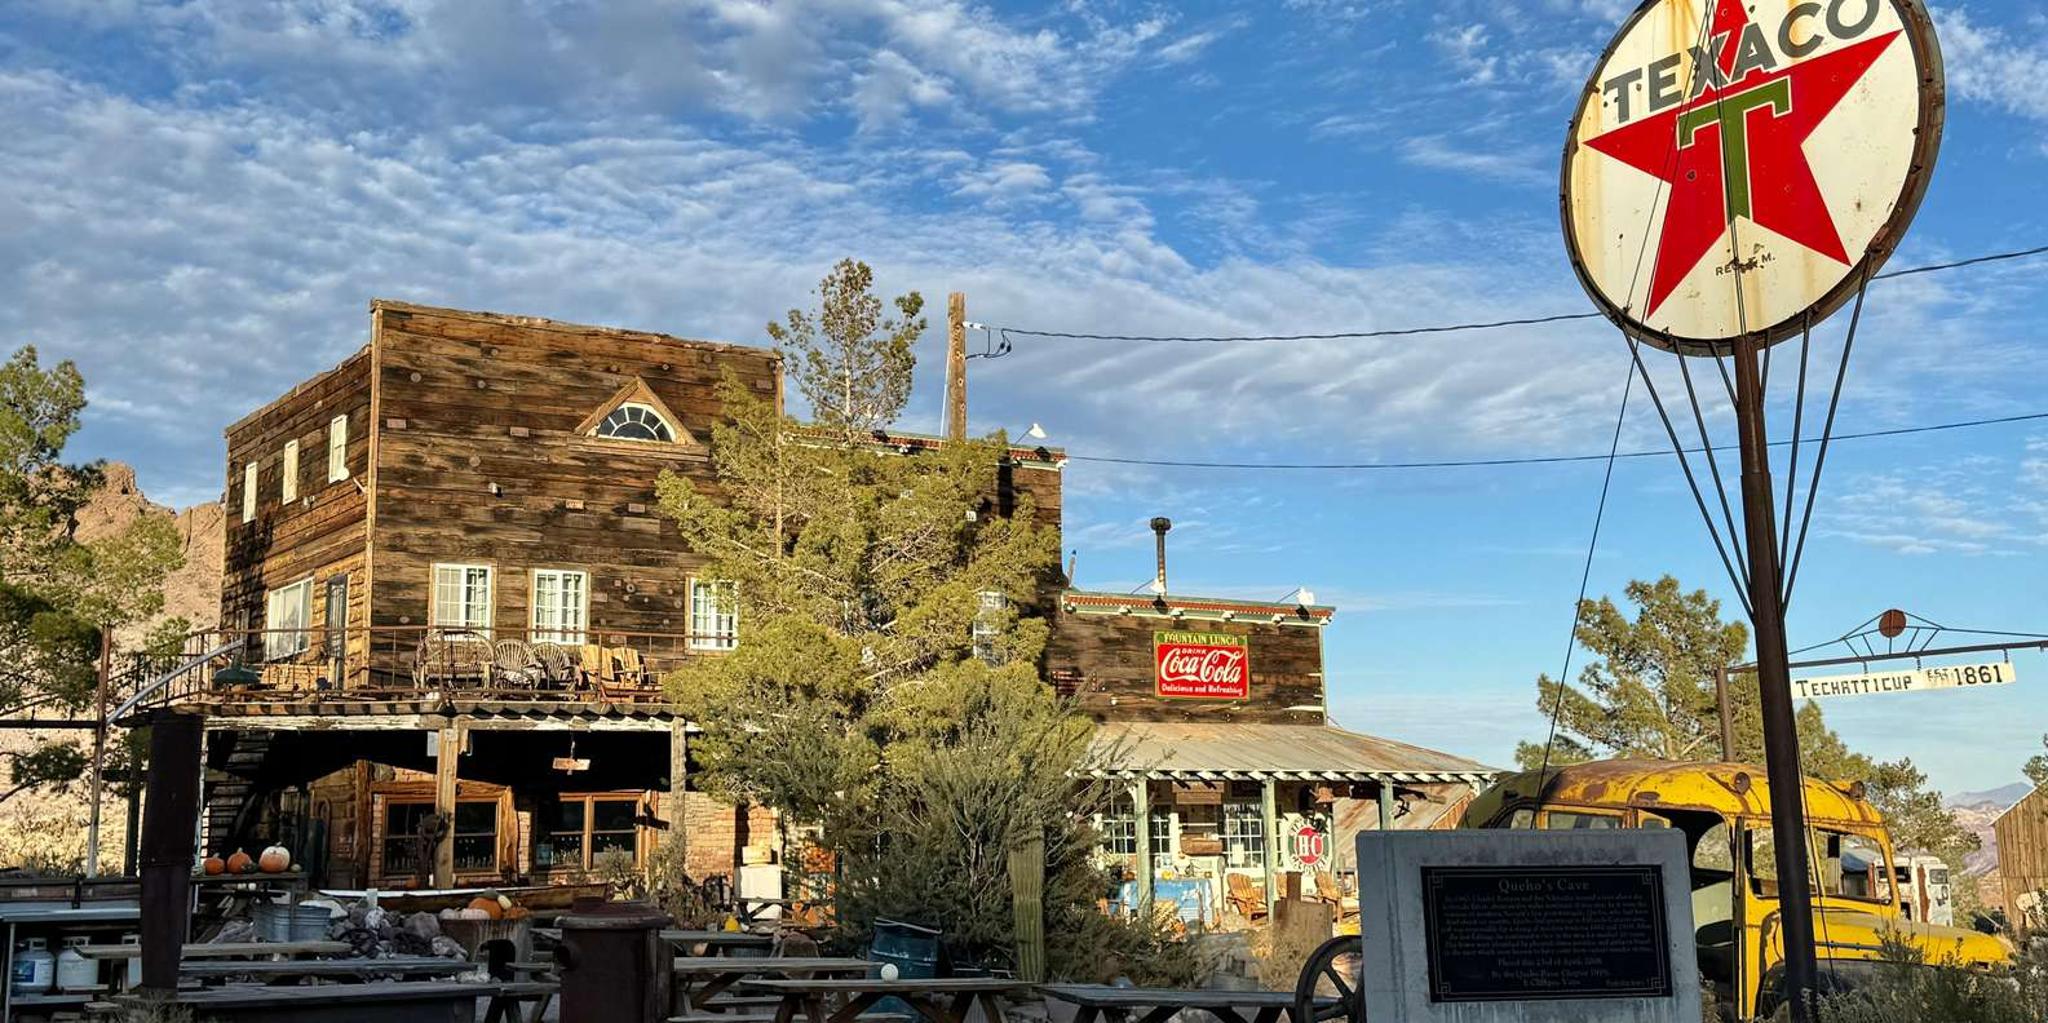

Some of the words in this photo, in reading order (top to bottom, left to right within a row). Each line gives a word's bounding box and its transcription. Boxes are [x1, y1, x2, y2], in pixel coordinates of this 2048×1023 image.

[1604, 0, 1880, 124] TEXACO
[1676, 76, 1793, 226] T
[1164, 633, 1207, 645] FOUNTAIN
[1210, 635, 1239, 646] LUNCH
[1161, 683, 1193, 692] Delicious
[1208, 685, 1243, 697] Refreshing
[1795, 675, 1913, 697] TECHATTICUP
[1953, 664, 2004, 686] 1861
[1498, 879, 1553, 894] Queho's
[1557, 878, 1590, 891] Cave
